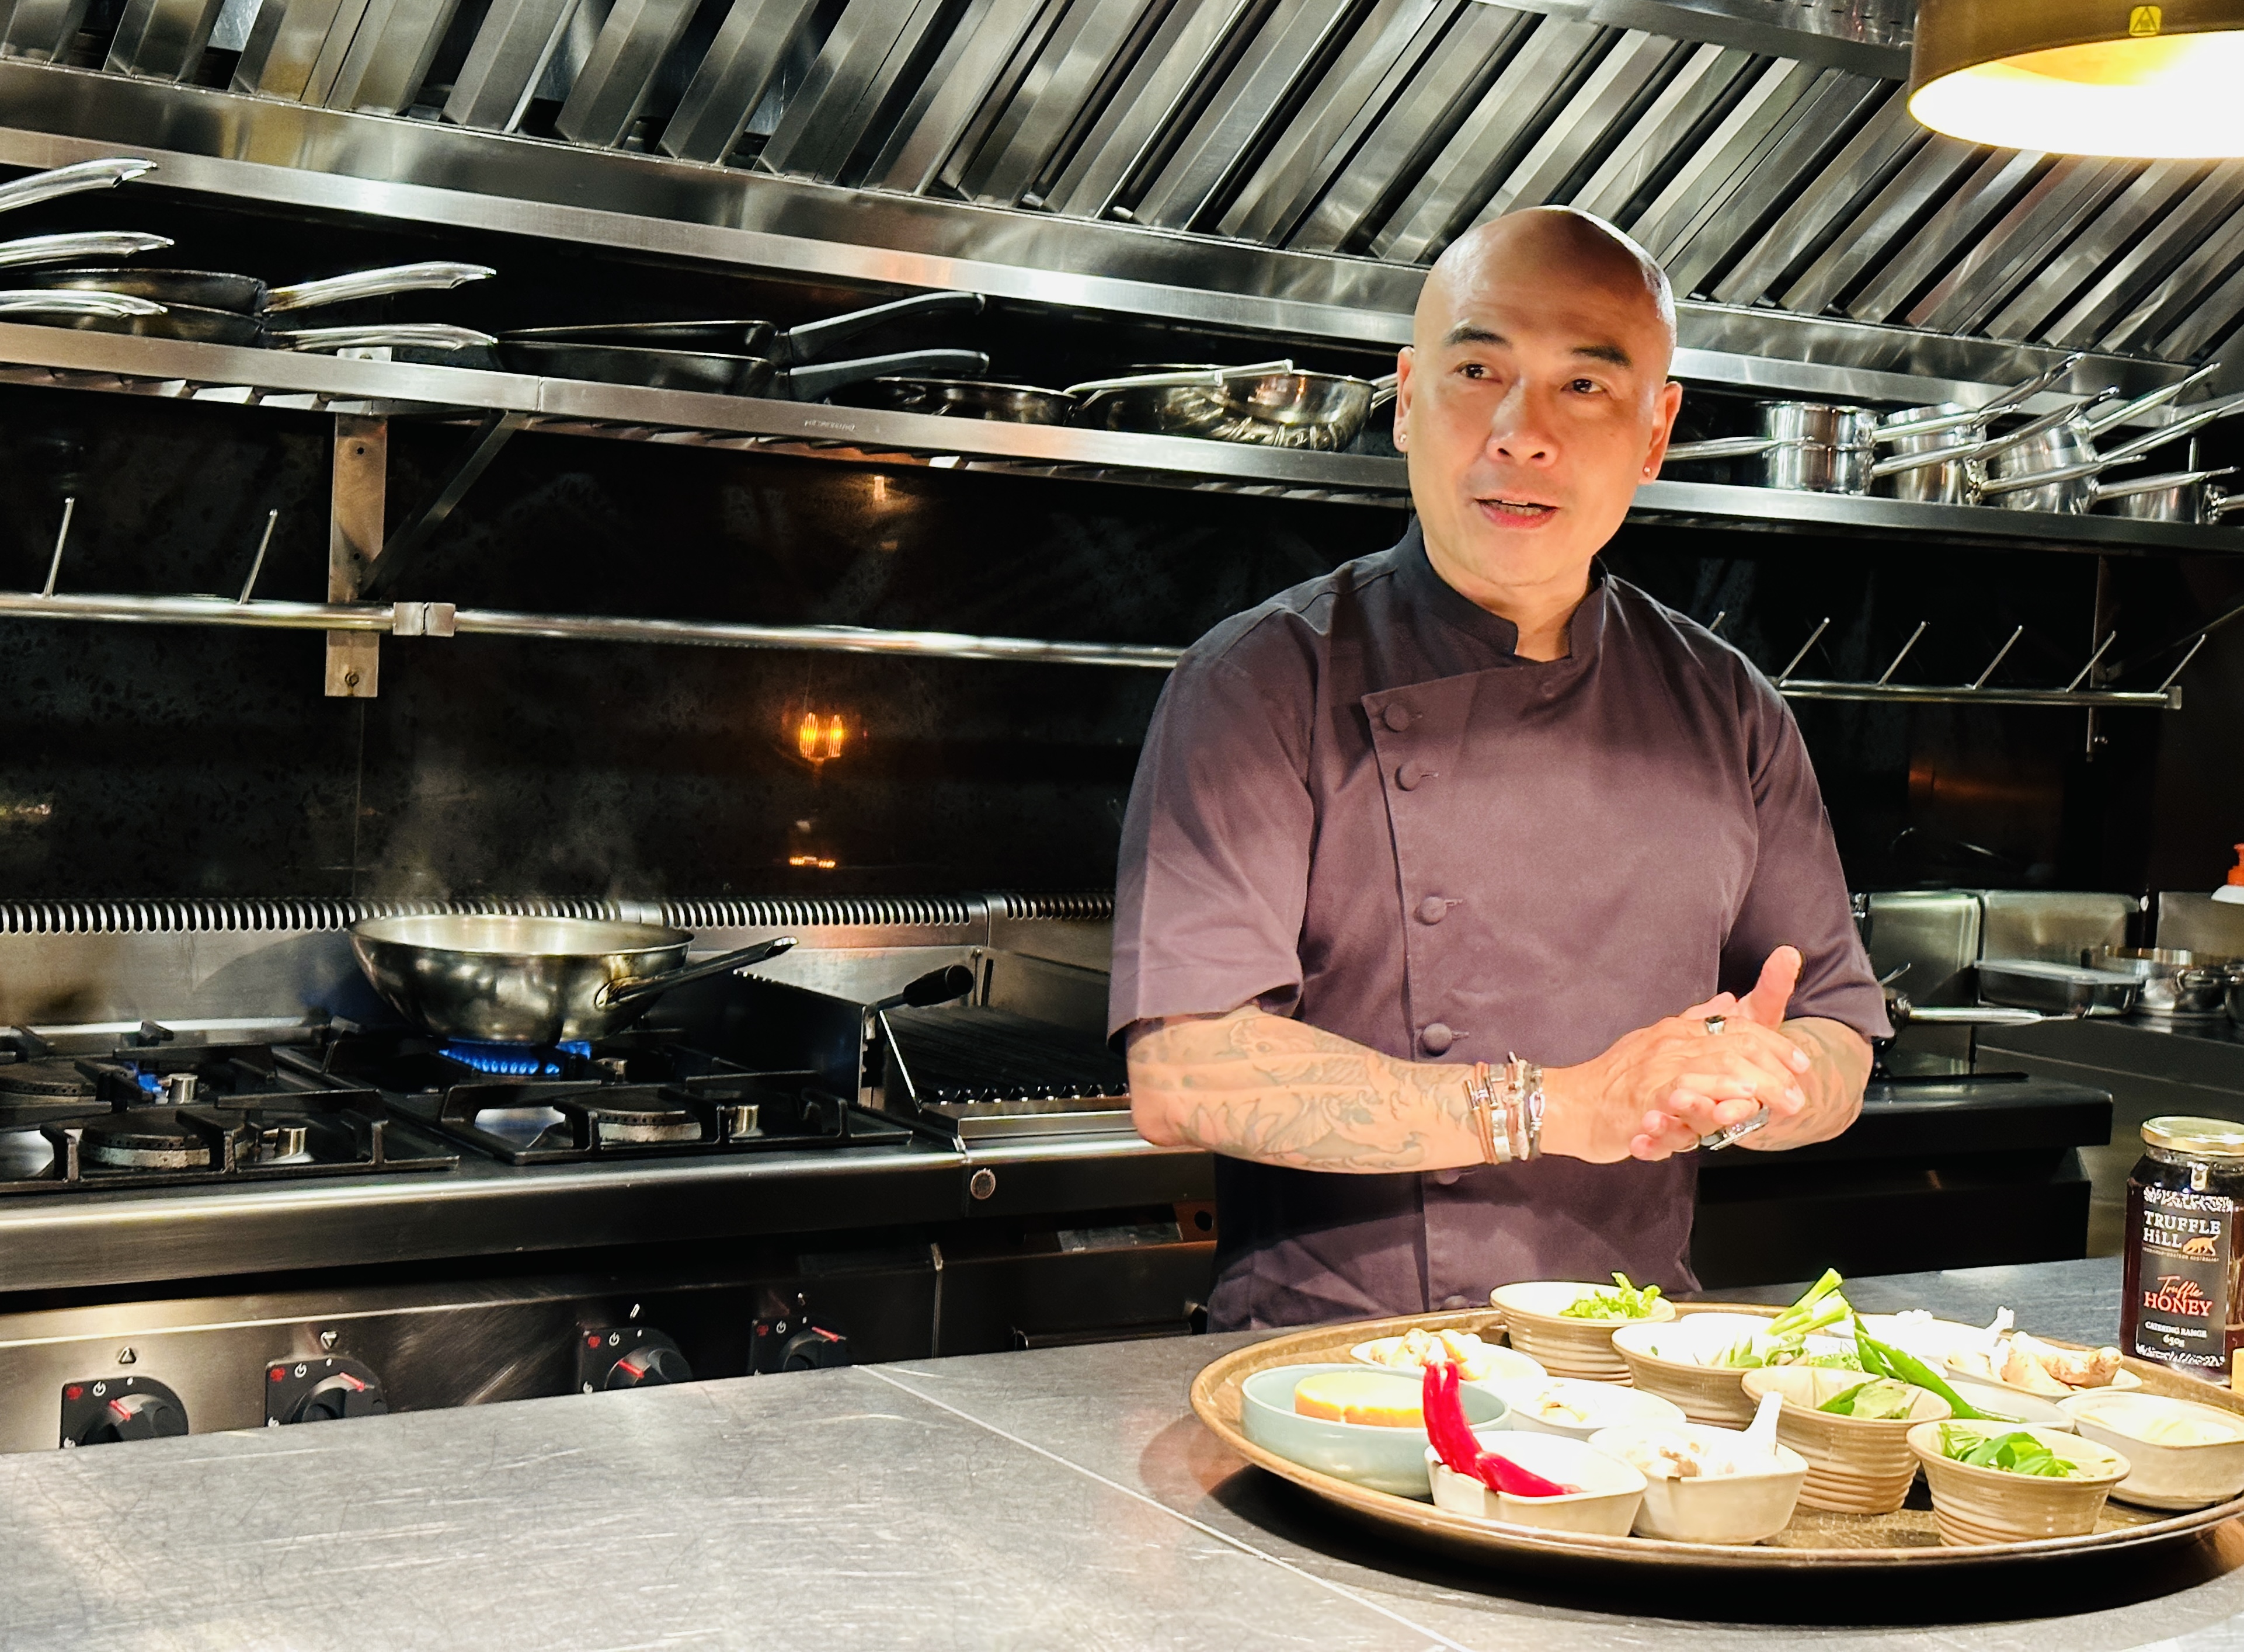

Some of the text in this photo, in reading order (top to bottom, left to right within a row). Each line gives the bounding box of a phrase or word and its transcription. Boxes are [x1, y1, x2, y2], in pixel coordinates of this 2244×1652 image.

[2144, 1210, 2221, 1234] TRUFFLE
[2157, 1275, 2204, 1300] Truffle
[2144, 1291, 2212, 1317] HONEY
[2163, 1334, 2185, 1348] 650g
[2180, 1327, 2207, 1338] RANGE
